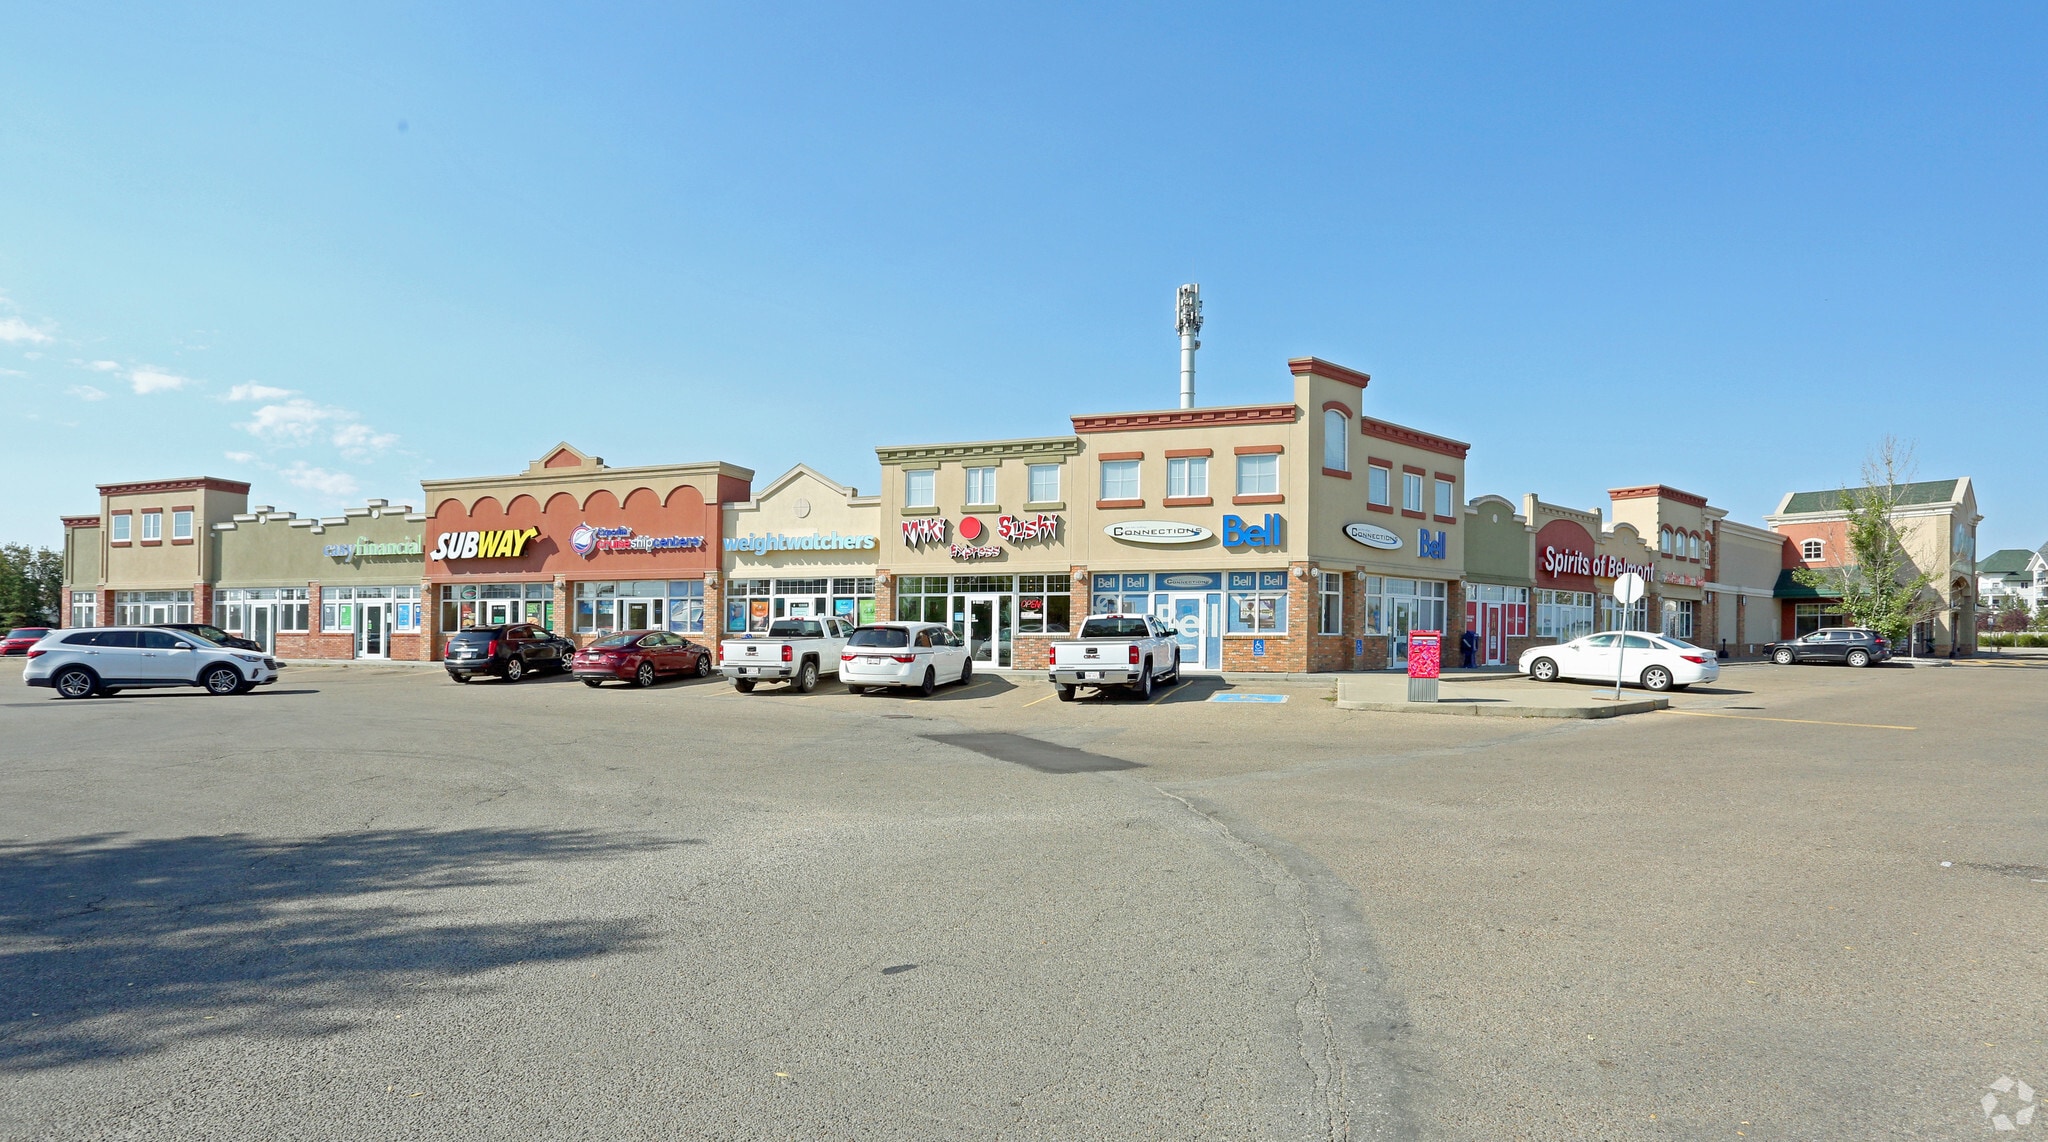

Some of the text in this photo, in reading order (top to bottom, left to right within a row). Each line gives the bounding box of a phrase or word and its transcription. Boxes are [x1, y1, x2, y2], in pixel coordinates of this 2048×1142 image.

[902, 513, 1058, 547] Miki Sushi
[1222, 513, 1281, 547] Bell
[430, 527, 538, 561] SUBWAY
[1418, 528, 1446, 559] Bell
[951, 544, 1001, 560] Express
[1545, 545, 1591, 578] Spirits
[1592, 556, 1606, 577] of
[1607, 555, 1655, 582] Belmont
[1098, 577, 1115, 588] Bell
[1127, 577, 1145, 588] Bell
[1233, 575, 1252, 586] Bell
[1264, 575, 1283, 586] Bell
[1021, 600, 1043, 609] OPEN
